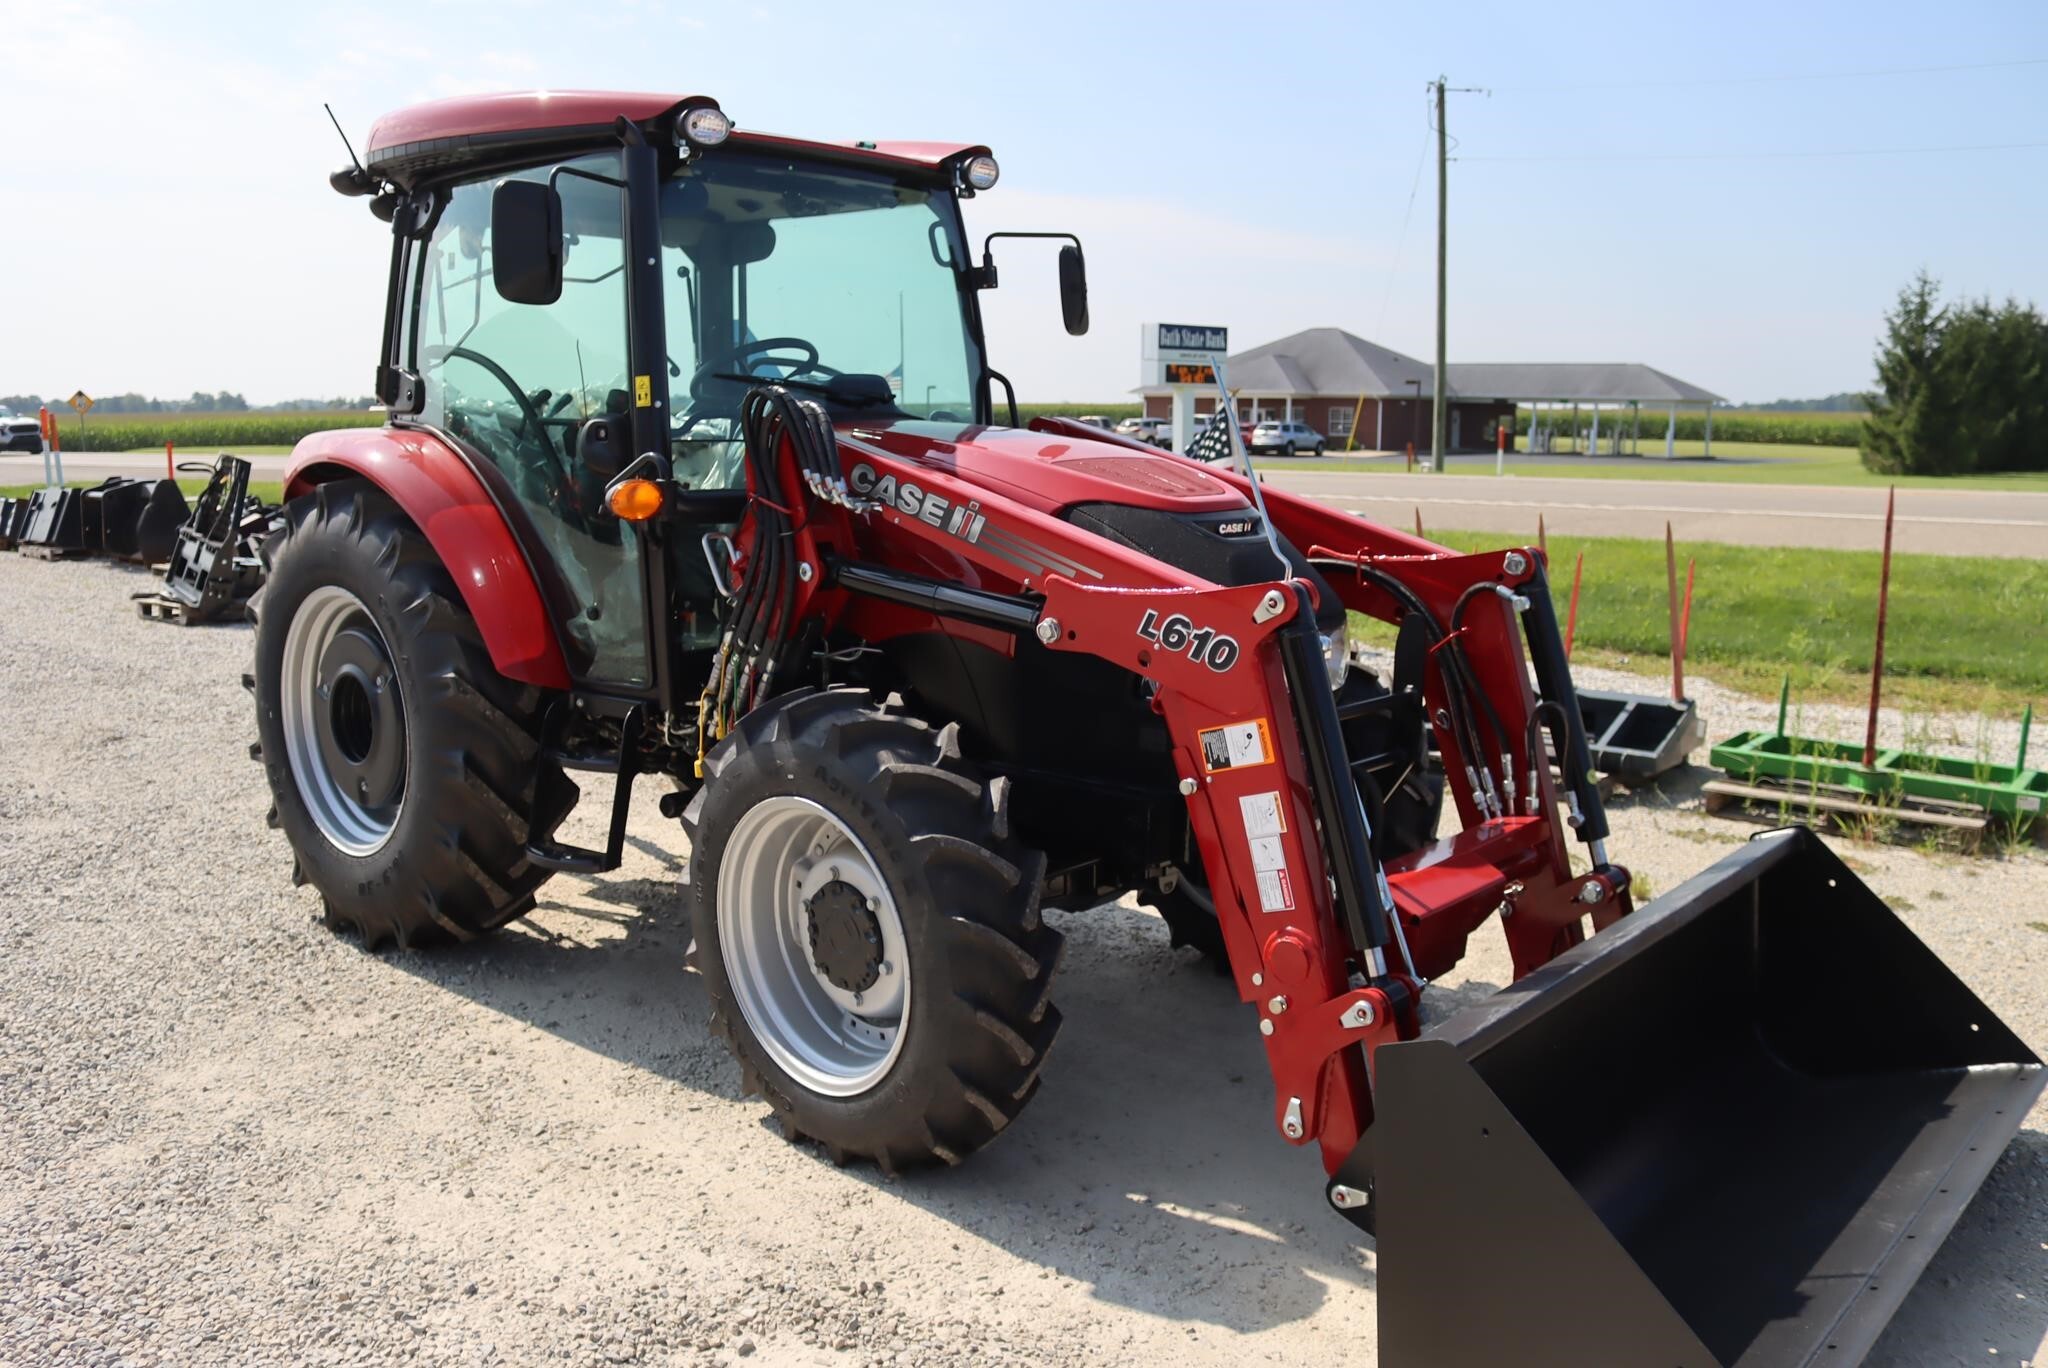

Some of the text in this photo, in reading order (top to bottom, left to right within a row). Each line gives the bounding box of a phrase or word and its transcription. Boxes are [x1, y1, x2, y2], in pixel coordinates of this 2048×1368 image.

[1181, 328, 1204, 347] State
[1205, 329, 1225, 348] Bank
[850, 463, 949, 528] CASE
[1219, 523, 1244, 534] CASE
[1137, 608, 1239, 673] L610
[1280, 877, 1292, 907] DANGER
